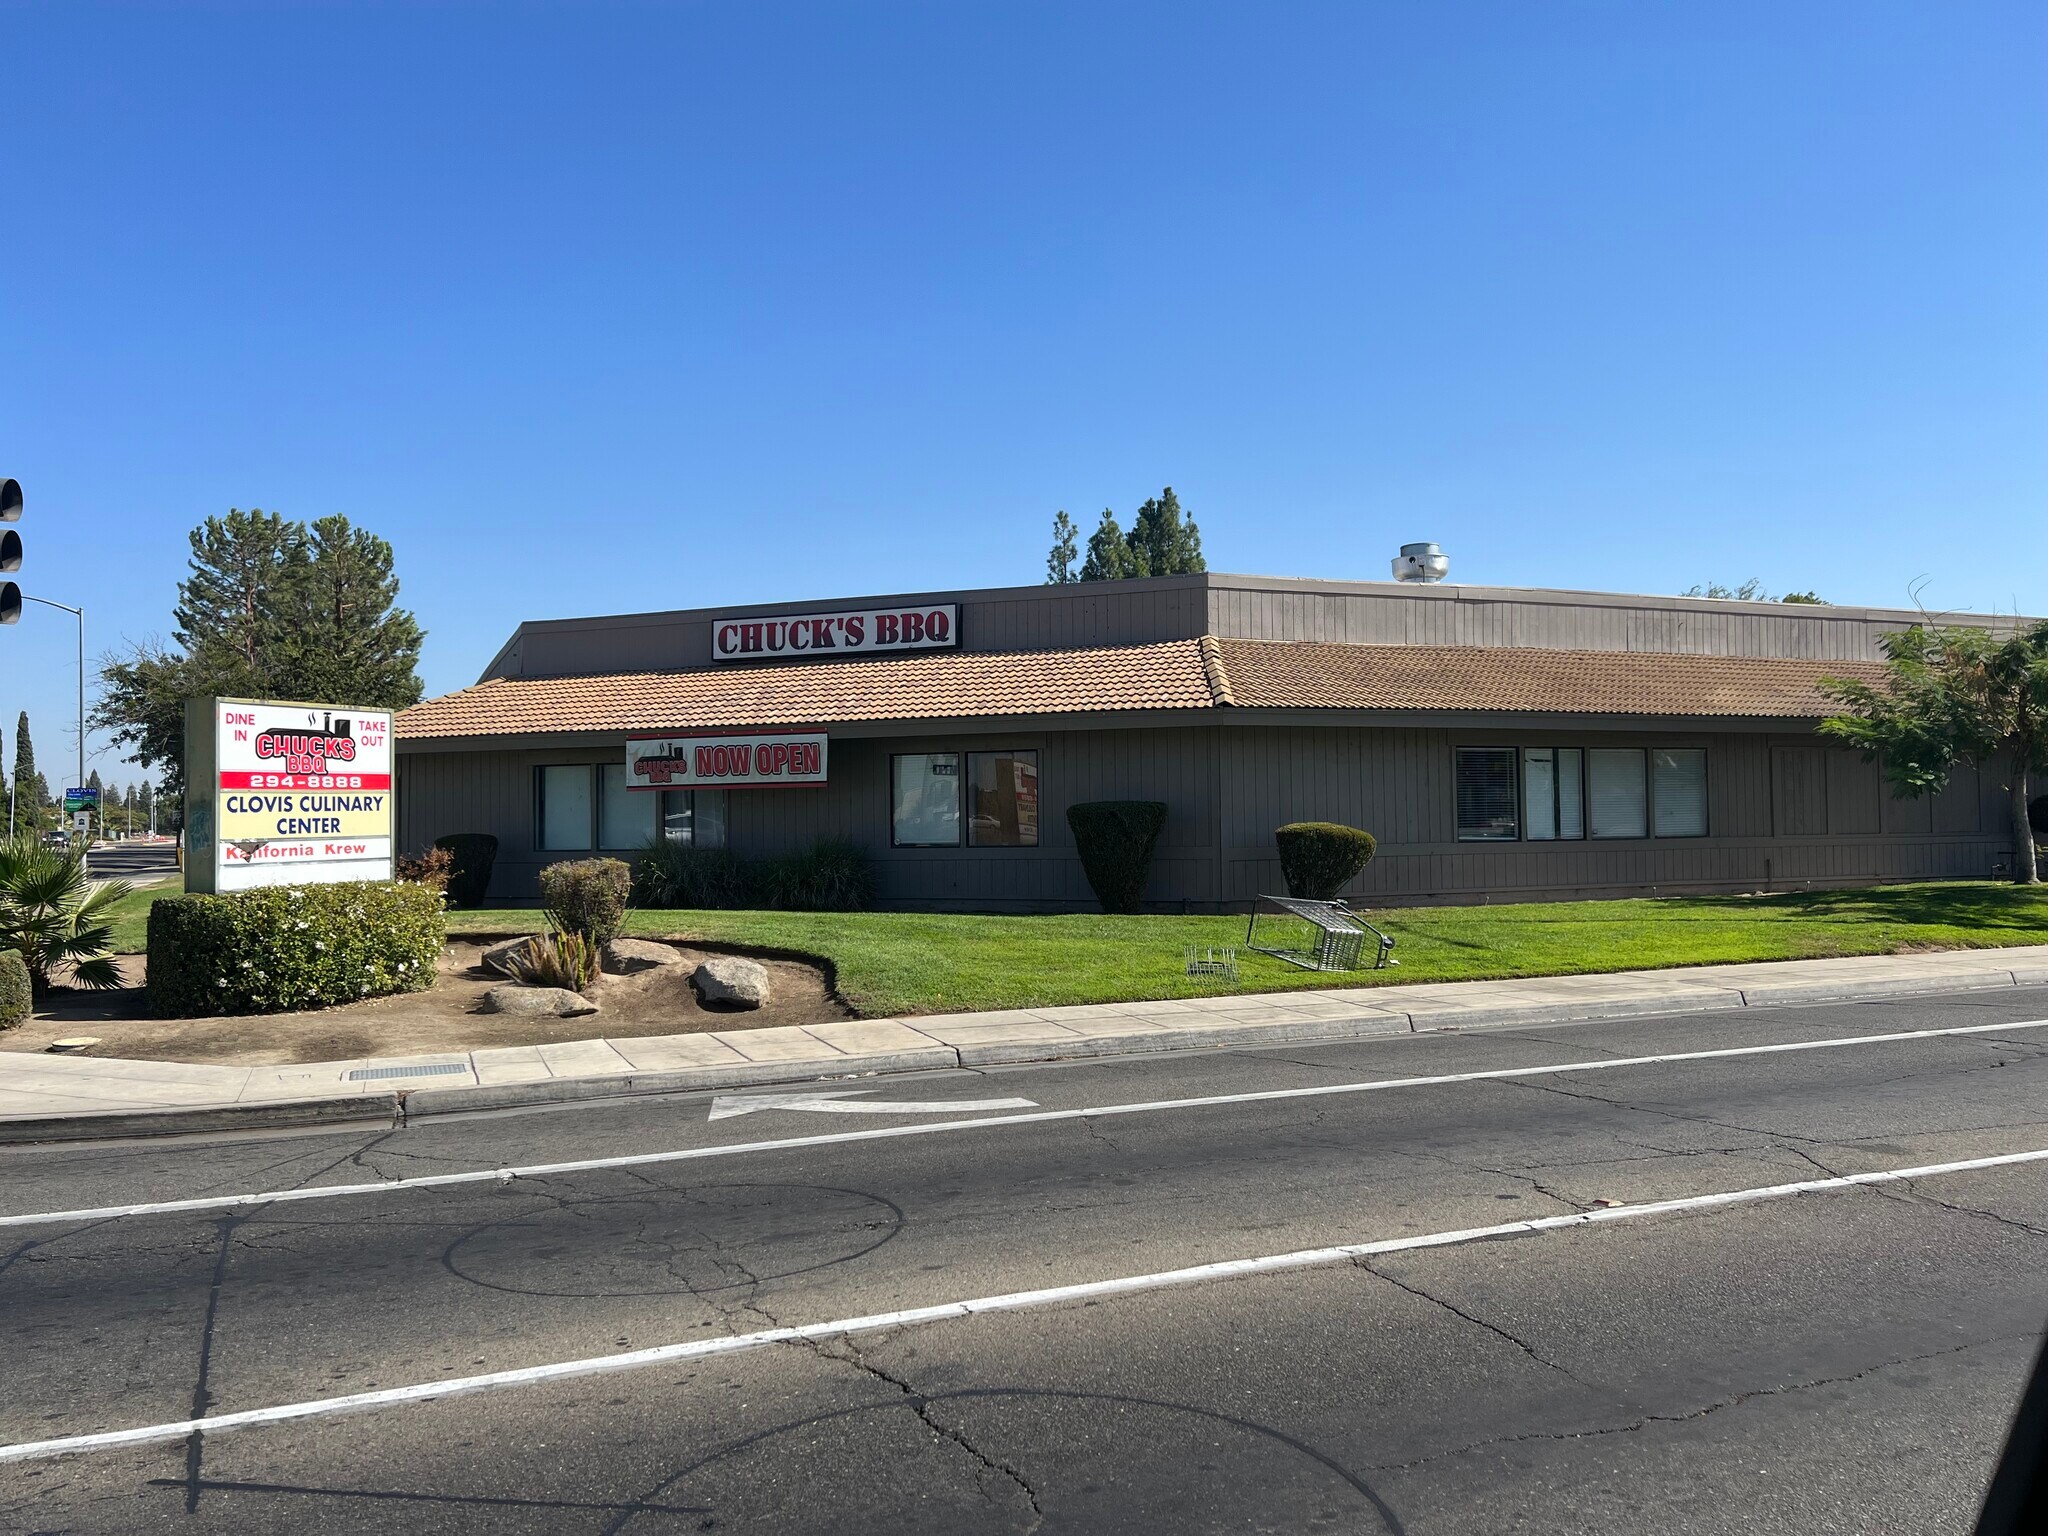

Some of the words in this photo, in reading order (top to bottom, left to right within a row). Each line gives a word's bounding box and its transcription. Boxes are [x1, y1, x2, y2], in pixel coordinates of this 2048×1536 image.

[717, 615, 865, 655] CHUCK'S
[874, 610, 950, 645] BBQ
[225, 712, 256, 726] DINE
[358, 720, 387, 732] TAKE
[234, 730, 248, 742] IN
[360, 736, 384, 747] OUT
[256, 733, 356, 761] CHUCKS
[286, 755, 328, 775] BBQ
[634, 759, 688, 776] CHUCKS
[695, 746, 752, 776] NOW
[756, 743, 821, 775] OPEN
[250, 775, 362, 788] 294-8888
[226, 796, 294, 813] CLOVIS
[300, 796, 384, 812] CULINARY
[277, 817, 341, 835] CENTER
[325, 844, 366, 855] Krew
